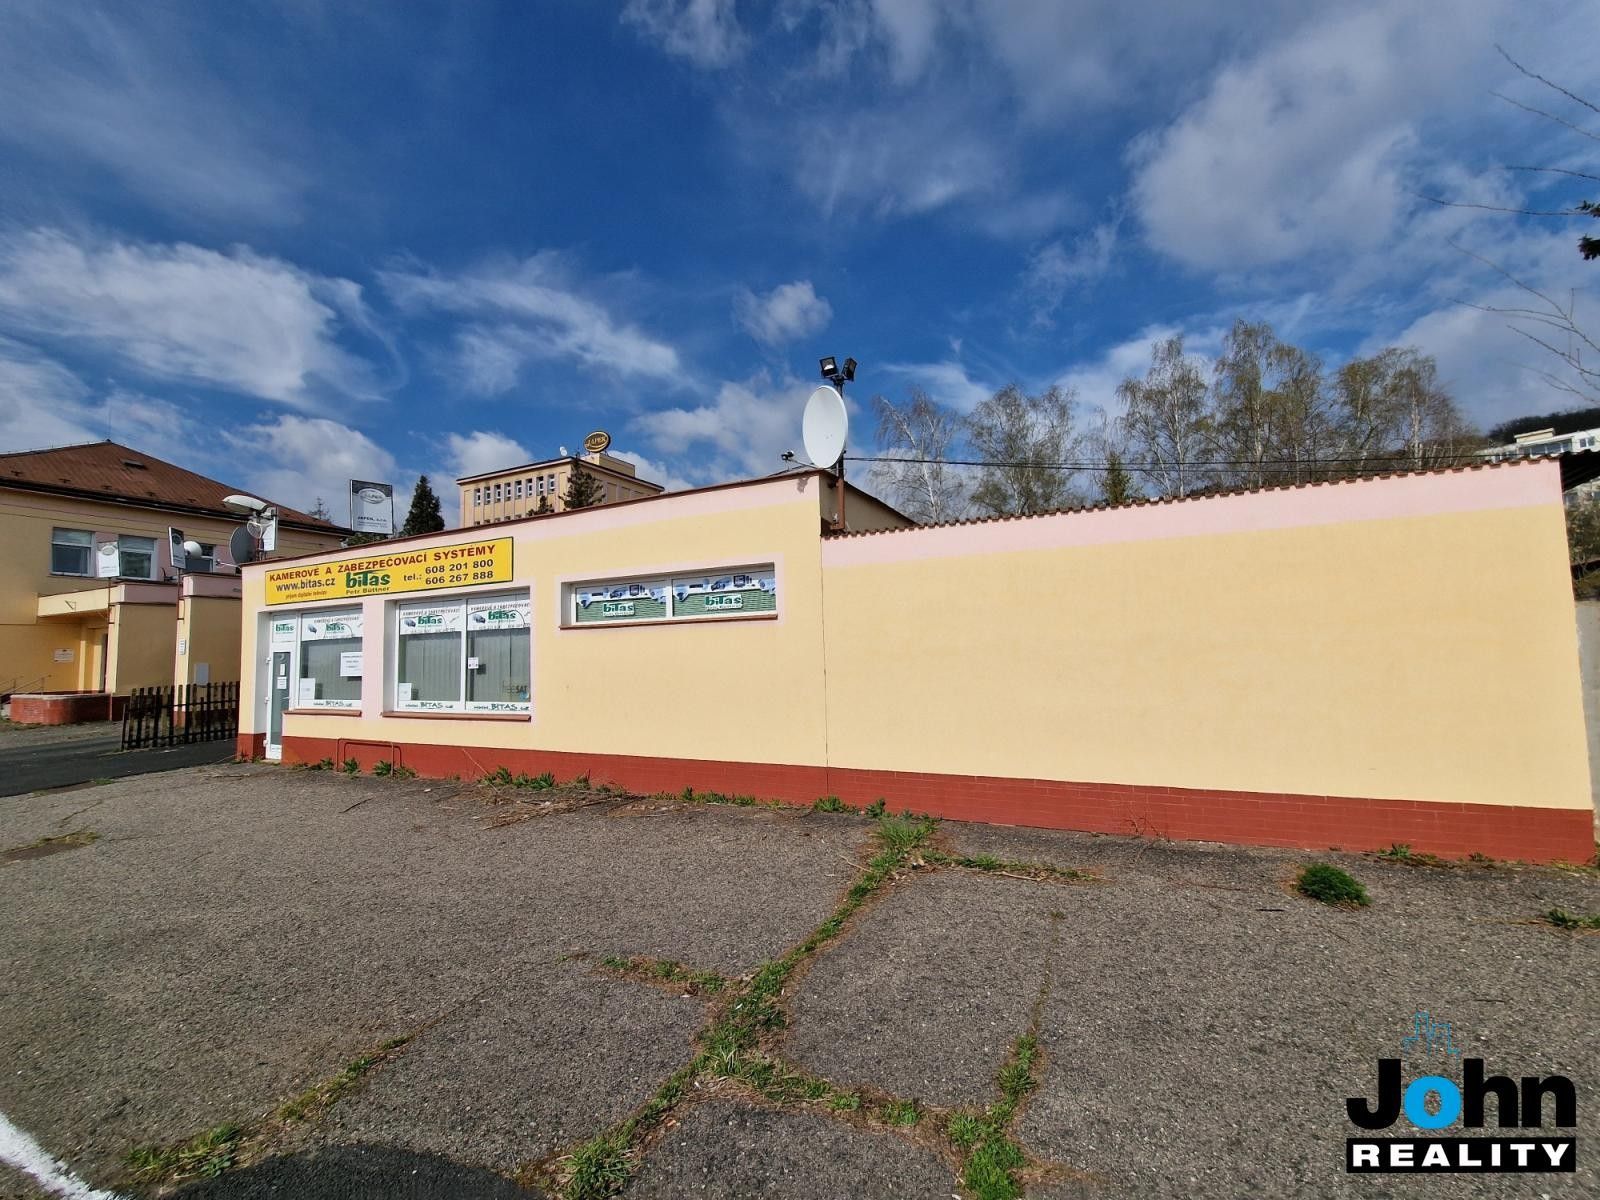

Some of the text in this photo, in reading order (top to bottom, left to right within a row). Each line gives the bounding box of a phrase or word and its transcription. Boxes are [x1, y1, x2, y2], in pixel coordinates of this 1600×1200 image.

[269, 567, 320, 582] KAMEROVÉ
[337, 553, 427, 573] ZABEZPEČOVACÍ
[433, 545, 496, 561] SYSTÉMY
[425, 559, 494, 575] 608 201 800
[276, 577, 336, 592] www.bitas.cz
[403, 573, 422, 582] tel.:
[425, 570, 494, 586] 606 267 888
